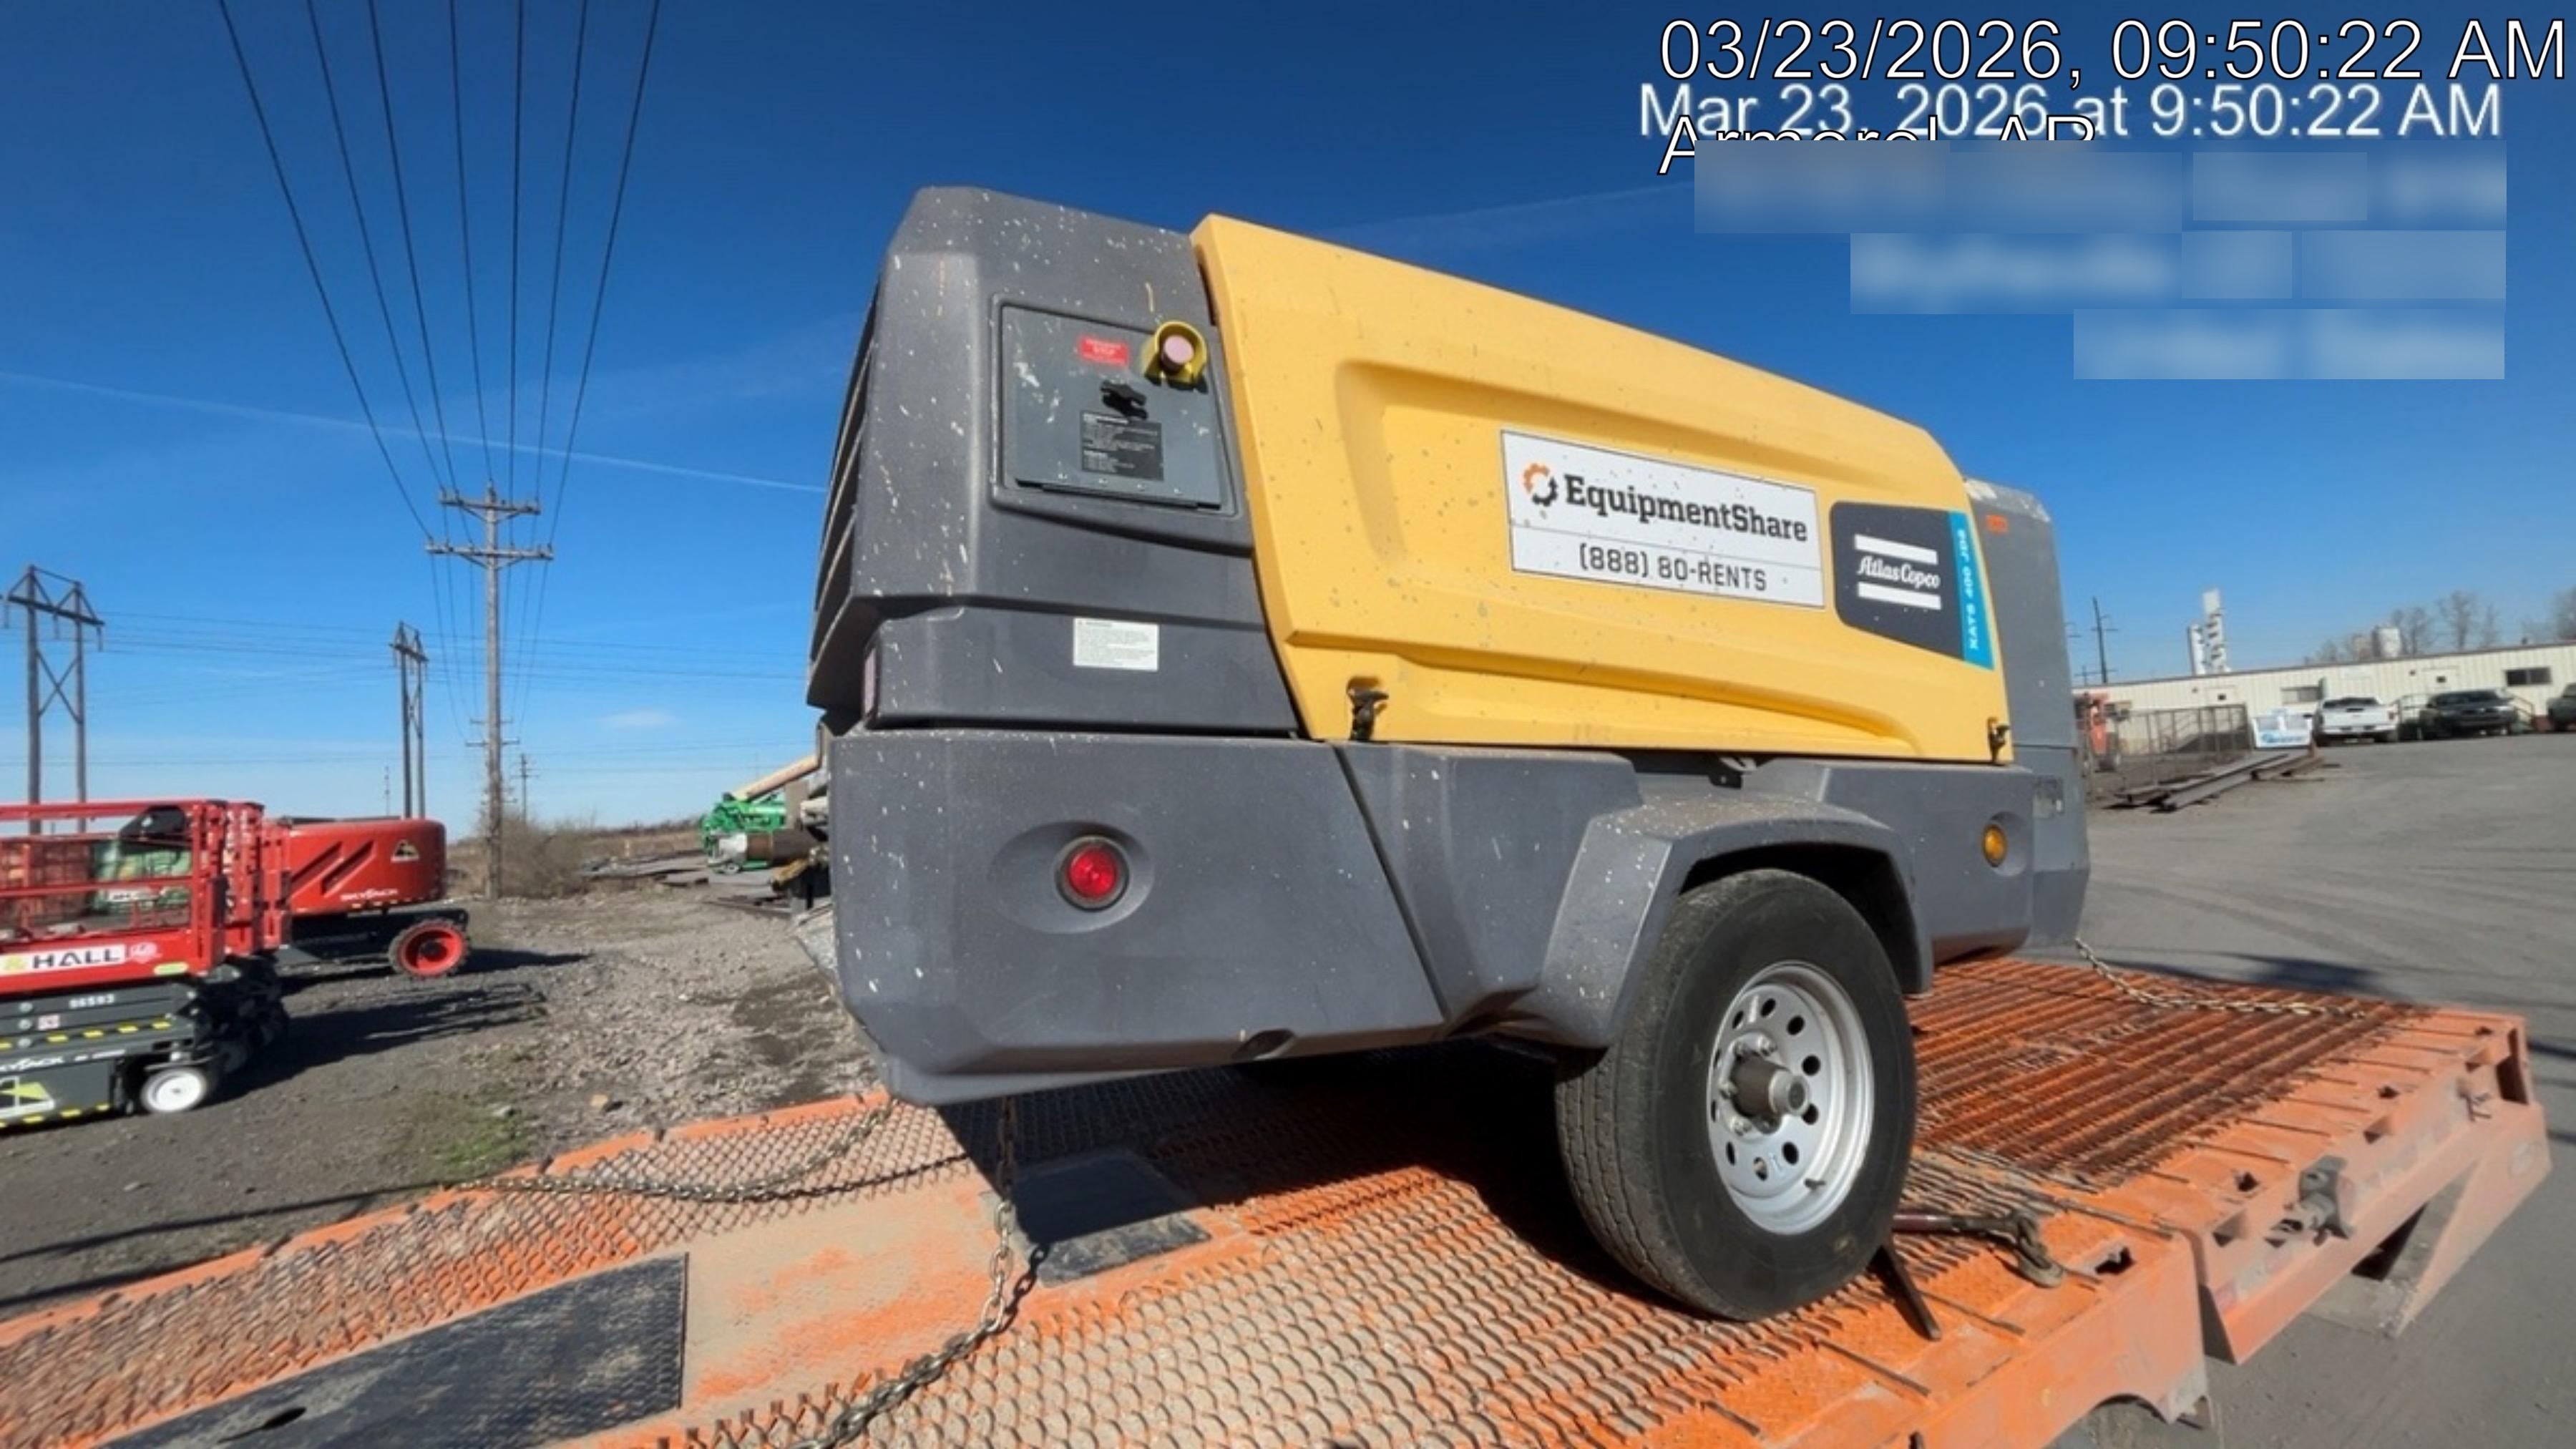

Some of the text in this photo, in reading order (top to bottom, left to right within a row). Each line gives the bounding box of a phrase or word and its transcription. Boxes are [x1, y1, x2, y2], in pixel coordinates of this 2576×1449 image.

[1564, 474, 1807, 542] EquipmentShare
[1579, 542, 1767, 592] (888) 80-RENTS
[32, 949, 120, 969] HALL
